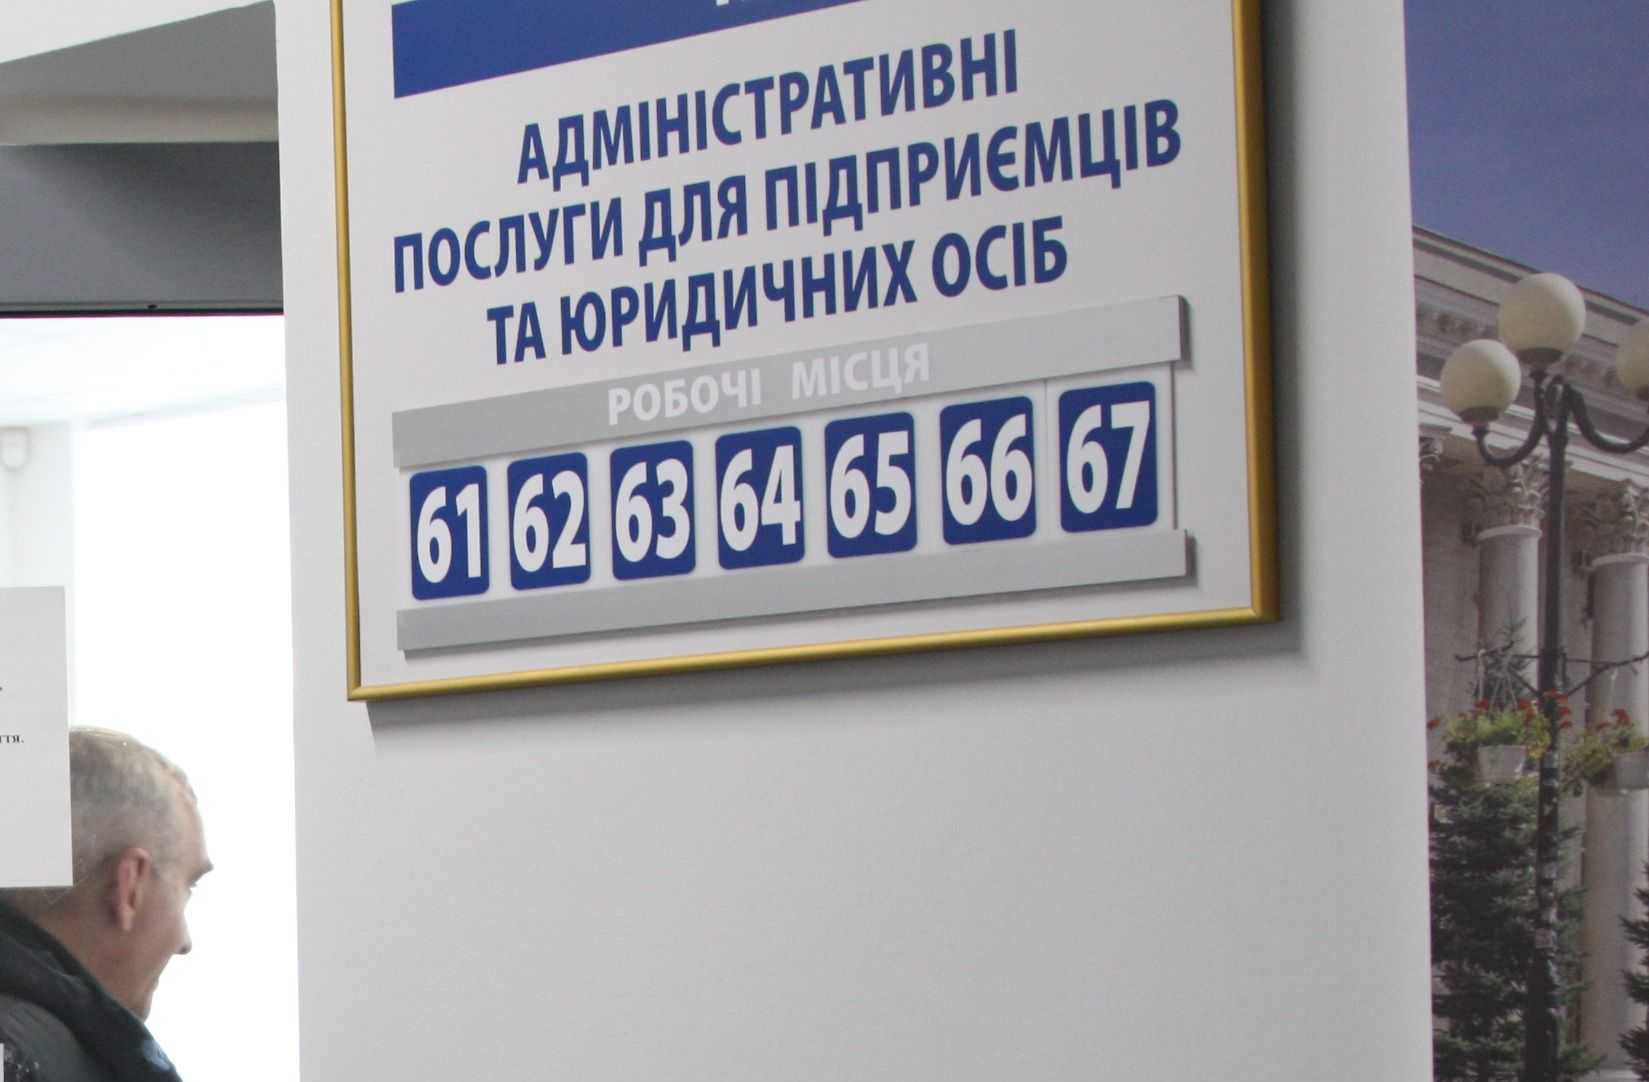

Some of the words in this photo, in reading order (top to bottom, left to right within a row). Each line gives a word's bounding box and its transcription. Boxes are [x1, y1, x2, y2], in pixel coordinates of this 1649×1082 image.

[516, 28, 1020, 191] АДМІНІСТРАТИВНІ
[393, 197, 624, 294] ПОСЛУГИ
[638, 180, 748, 267] ДЛЯ
[765, 98, 1182, 237] ПІДПРИЄМЦІВ
[486, 302, 546, 366] ТА
[560, 239, 918, 357] ЮРИДИЧНИХ
[931, 215, 1069, 291] ОСІБ
[606, 367, 763, 427] РОБОЧІ
[790, 343, 931, 402] МІСЦЯ
[415, 482, 483, 585] 61
[512, 469, 588, 571] 62
[614, 458, 692, 562] 63
[719, 444, 802, 550] 64
[829, 431, 914, 536] 65
[945, 412, 1033, 525] 66
[1065, 400, 1152, 515] 67
